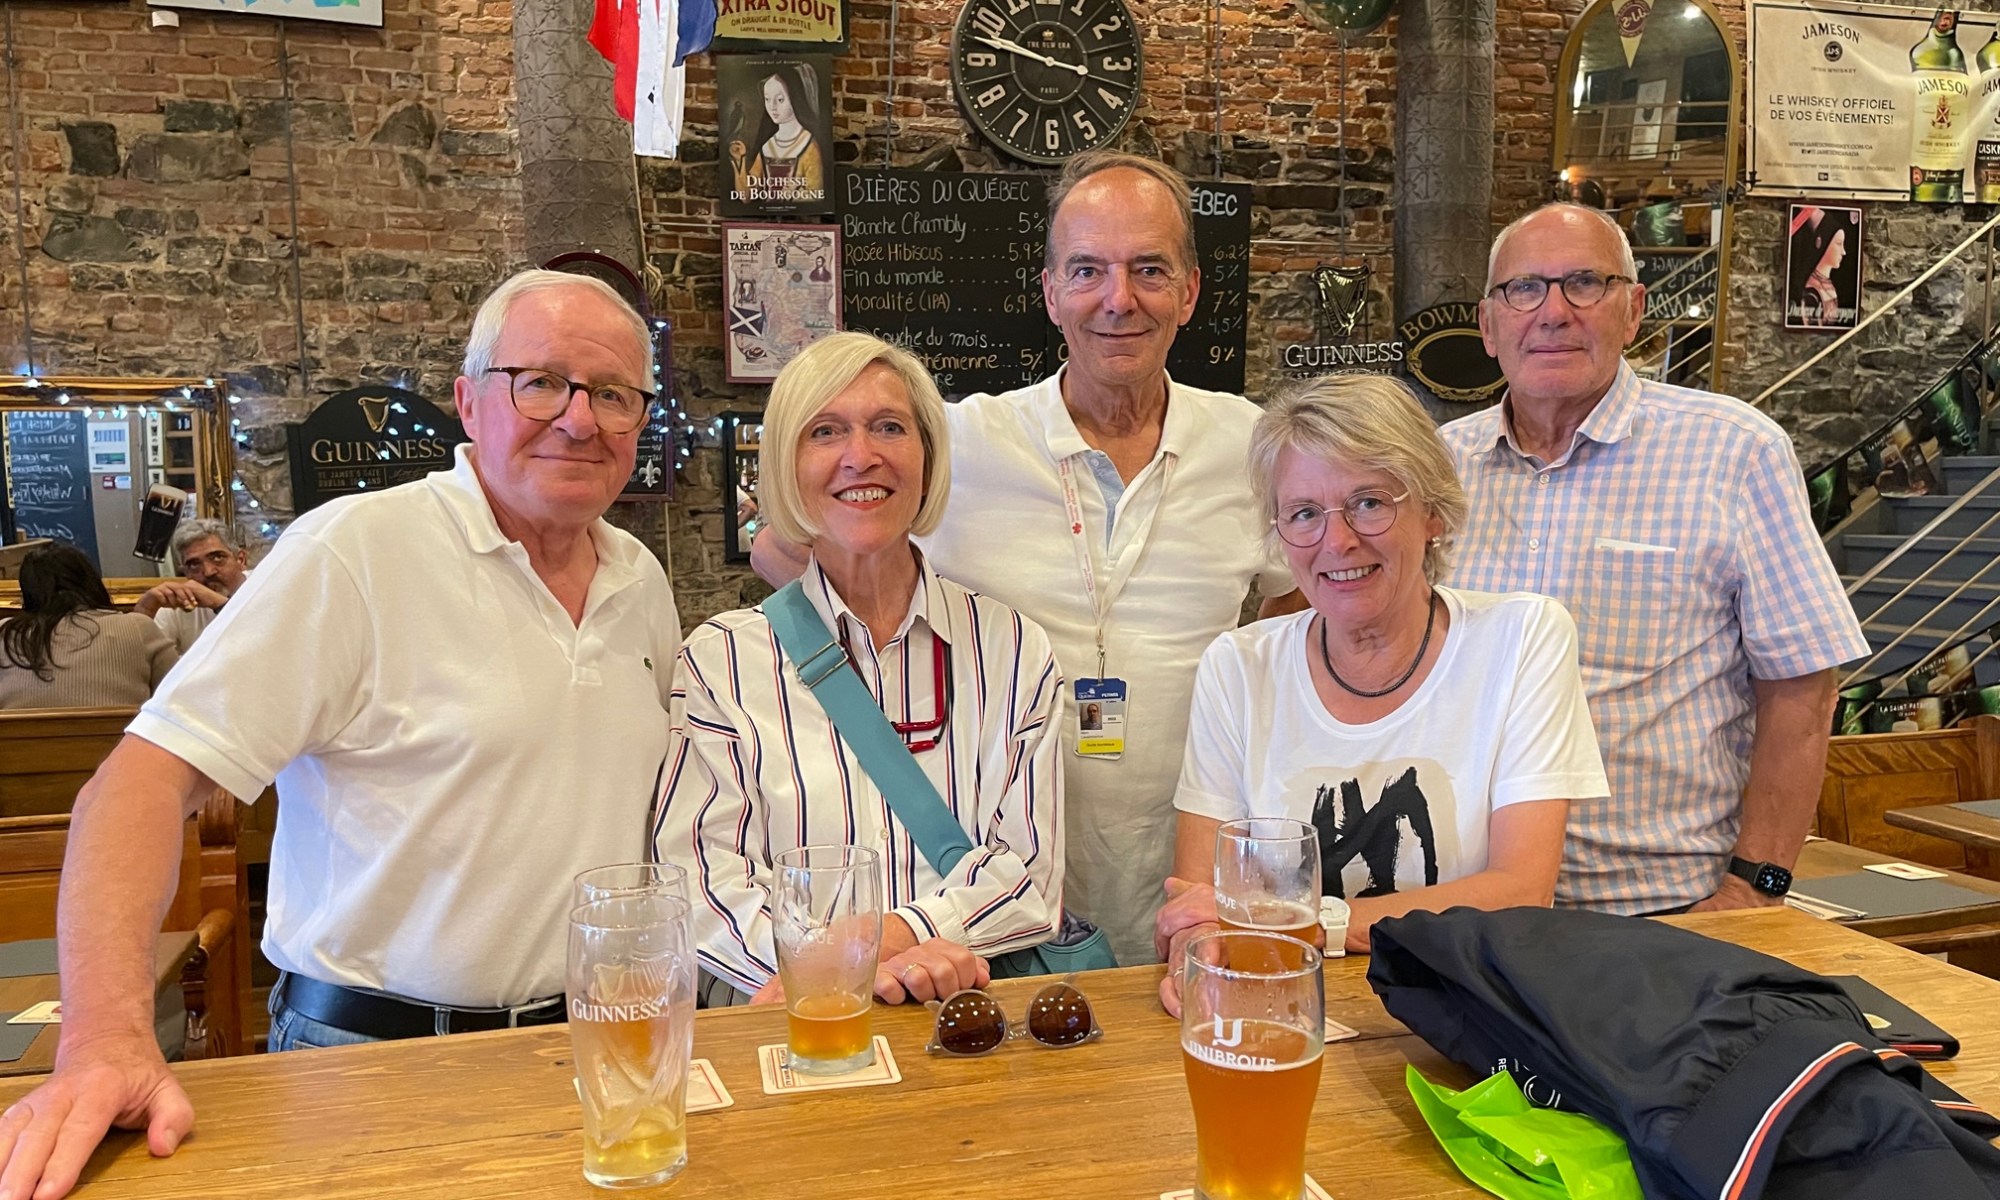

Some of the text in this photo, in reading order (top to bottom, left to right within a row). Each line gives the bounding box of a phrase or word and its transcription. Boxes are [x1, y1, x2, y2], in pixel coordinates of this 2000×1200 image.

[742, 15, 771, 24] DRAUGHT
[773, 15, 777, 23] &
[780, 16, 787, 24] IN
[788, 17, 812, 30] BOTTLE
[1092, 15, 1122, 40] 2
[1802, 22, 1860, 44] JAMESON
[966, 53, 996, 67] 9
[1102, 57, 1132, 71] 3
[977, 84, 1006, 108] 8
[1097, 87, 1124, 110] 4
[1918, 78, 1968, 98] JAMESON
[1769, 94, 1896, 110] LE WHISKEY OFFICIEL
[1009, 108, 1030, 138] 7
[1072, 109, 1097, 141] 5
[1770, 109, 1894, 125] DE VOS ÉVÉNEMENTS!
[1045, 119, 1059, 149] 6
[847, 173, 1030, 205] BIÈRES DU QUÉBEC
[844, 211, 1046, 243] Blanche Chambly 5%
[730, 242, 761, 251] TARTAN
[845, 242, 885, 266] Rosée
[888, 243, 944, 262] Hibiscus
[843, 269, 870, 289] Fin
[874, 269, 891, 285] du
[895, 266, 945, 286] monde
[1214, 264, 1239, 282] 5%
[844, 291, 914, 314] Moralité
[919, 290, 950, 313] (IPA)
[926, 326, 943, 346] du
[1285, 341, 1404, 367] GUINNESS
[311, 437, 446, 464] GUINNESS
[1879, 705, 1889, 713] LA
[1890, 704, 1907, 713] SAINT
[572, 998, 660, 1022] GUINNESS
[1189, 1040, 1276, 1072] UNIBROUE
